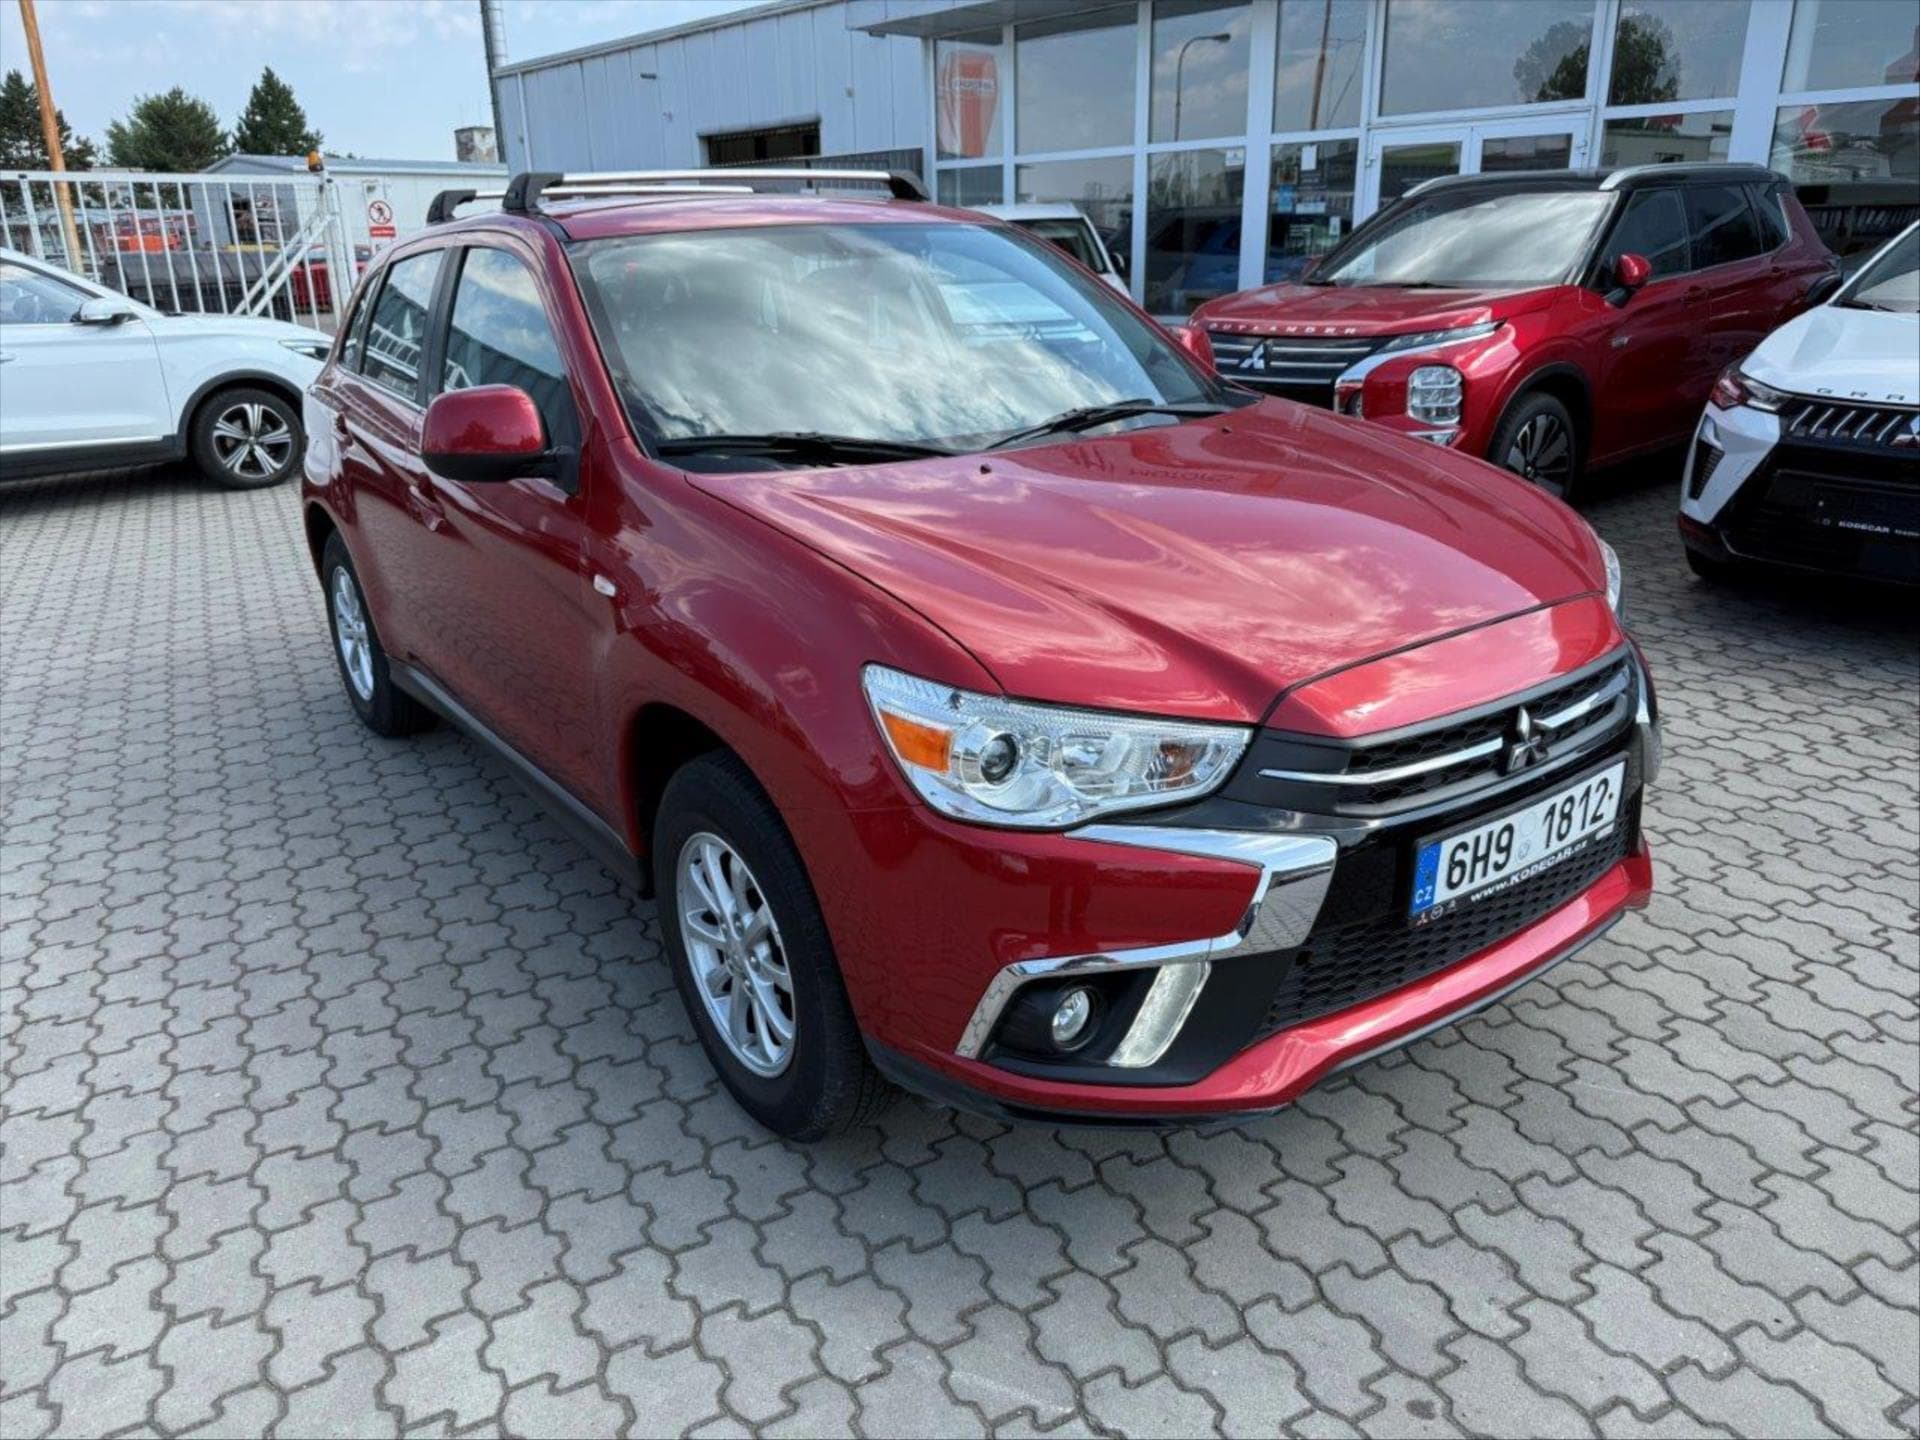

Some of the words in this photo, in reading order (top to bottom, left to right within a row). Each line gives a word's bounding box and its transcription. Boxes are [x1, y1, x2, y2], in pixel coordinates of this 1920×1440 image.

[1208, 322, 1357, 335] OUTLANDER
[1446, 822, 1514, 891] 6H9
[1541, 776, 1610, 850] 1812
[1414, 885, 1433, 904] CZ
